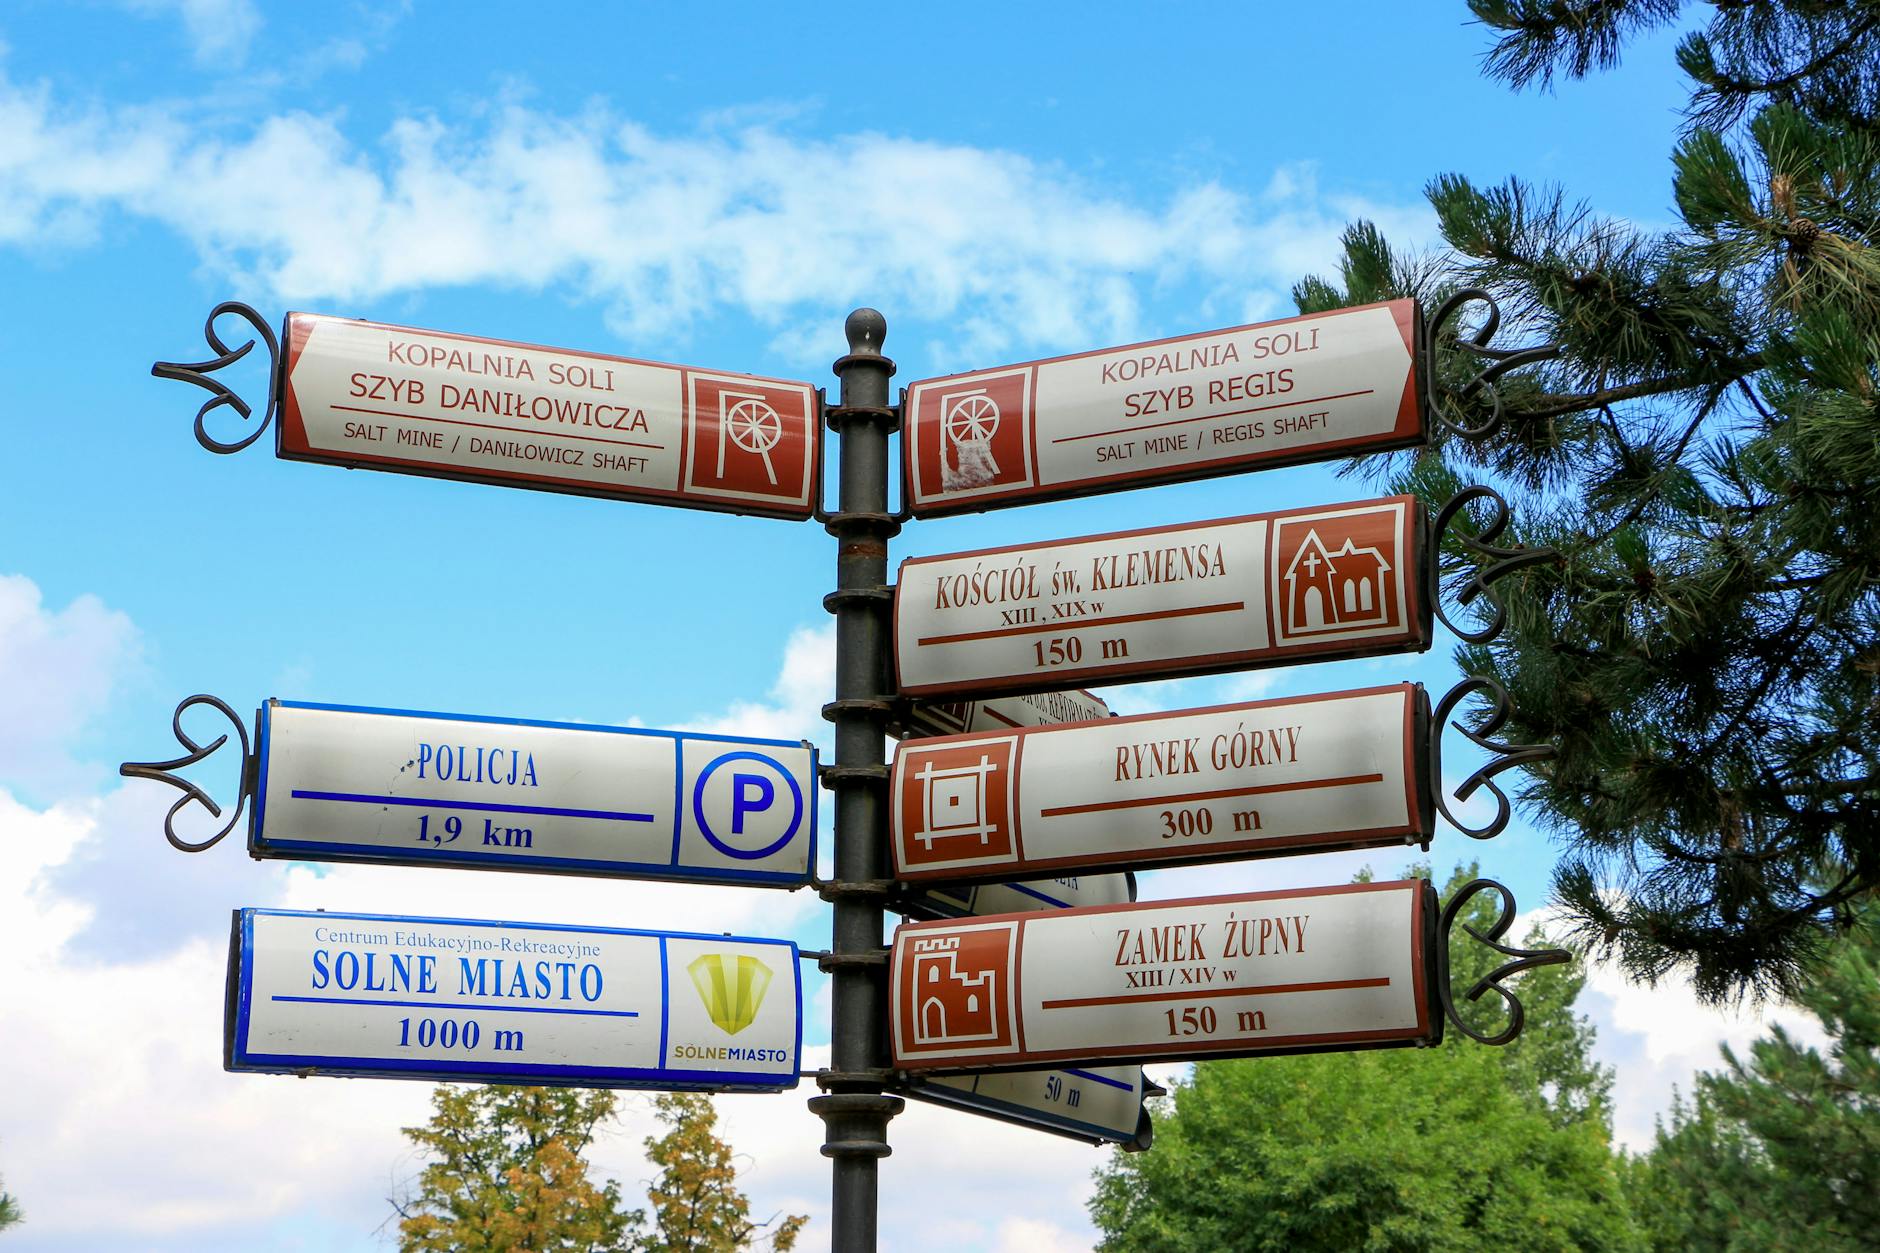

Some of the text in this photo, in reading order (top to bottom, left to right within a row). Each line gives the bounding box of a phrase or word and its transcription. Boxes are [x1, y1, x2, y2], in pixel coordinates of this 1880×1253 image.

[387, 340, 615, 391] KOPALNIA SOLI
[1101, 328, 1320, 385] KOPALNIA SOLI
[349, 372, 649, 433] SZYB DANIŁOWICZA
[1125, 368, 1294, 418] SZYB REGIS
[343, 422, 649, 473] SALT MINE / DANIŁOWICZ SHAFT
[1096, 412, 1330, 463] SALT MINE / REGIS SHAFT
[935, 542, 1226, 609] KOŚCIÓŁ św. KLEMENSA
[1051, 600, 1087, 619] XIX
[1033, 636, 1129, 667] 150 m
[417, 743, 538, 788] POLICJA
[1115, 722, 1301, 782] RYNEK GÓRNY
[732, 773, 775, 834] P
[1160, 807, 1263, 839] 300 m
[416, 814, 533, 849] 1,9 km
[315, 927, 600, 958] Centrum Edukacyjno-Rekreacyjne
[1115, 911, 1309, 966] ZAMEK ŻUPNY
[312, 949, 604, 1002] SOLNE MIASTO
[1223, 969, 1237, 982] w
[399, 1017, 525, 1051] 1000 m
[1165, 1006, 1267, 1036] 150 m
[1068, 1088, 1081, 1107] m
